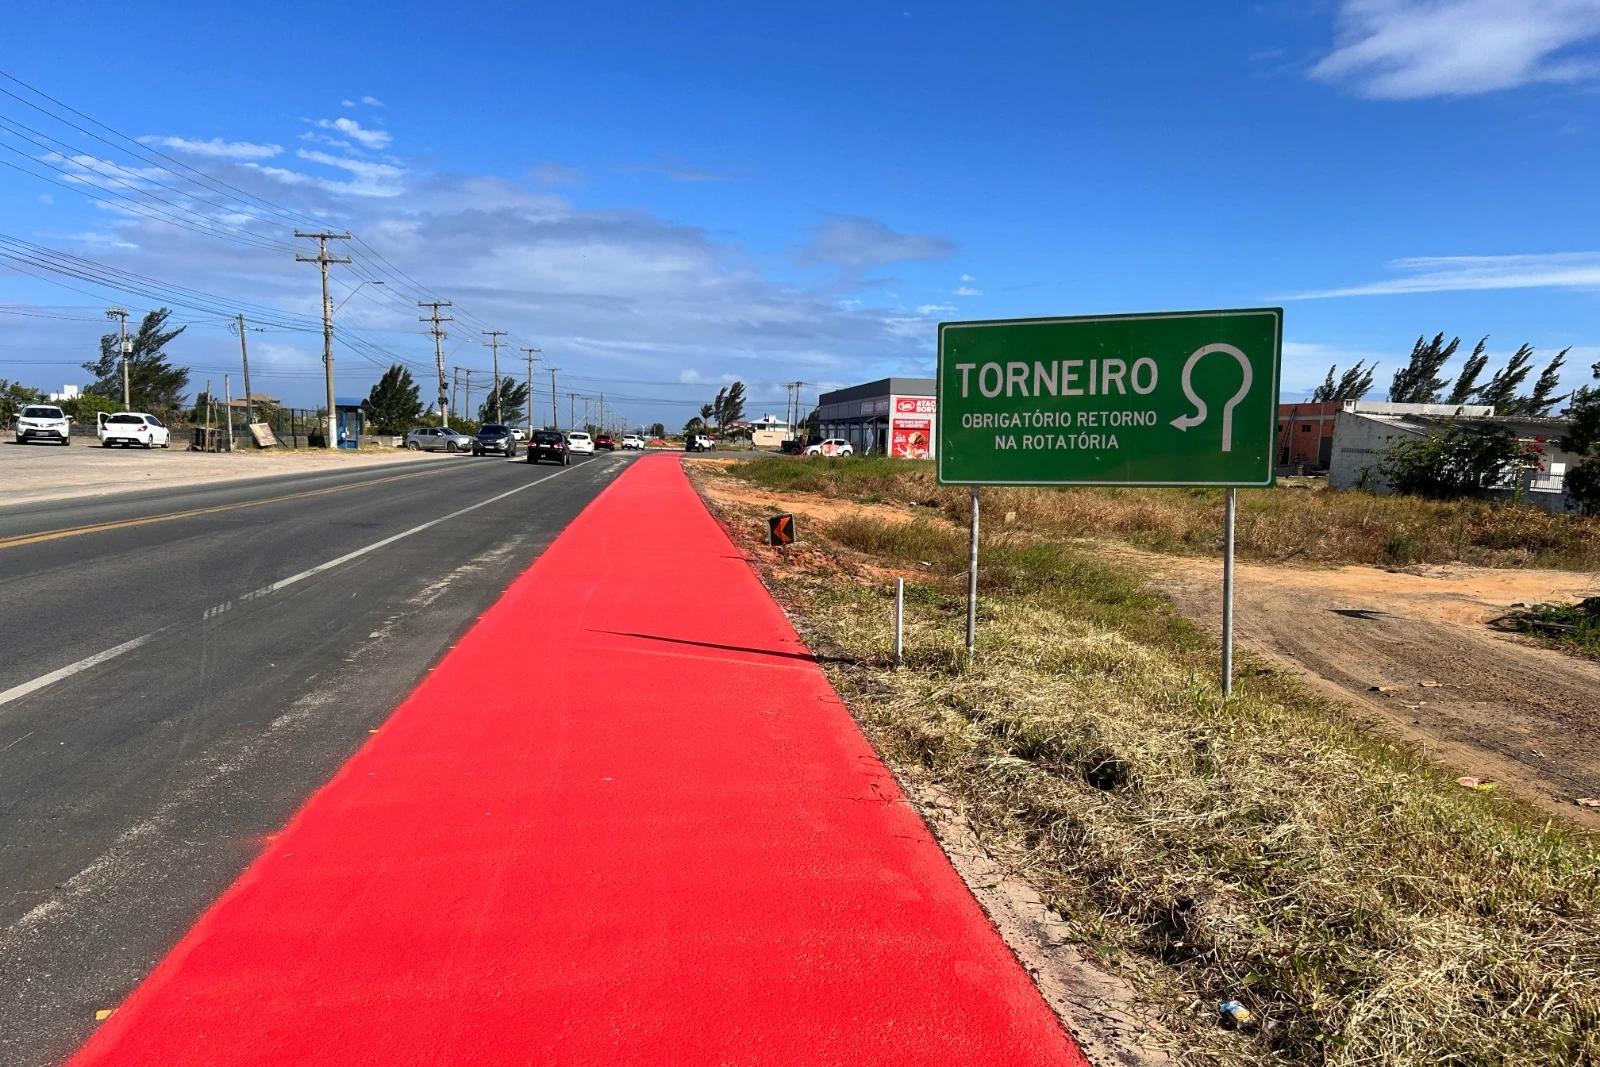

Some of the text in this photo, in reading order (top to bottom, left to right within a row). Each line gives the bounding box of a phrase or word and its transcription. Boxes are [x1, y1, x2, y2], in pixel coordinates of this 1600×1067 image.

[955, 357, 1158, 398] TORNEIRO
[962, 409, 1157, 428] OBRIGATÓRIO RETORNO
[995, 431, 1119, 450] NA ROTATÓRIA
